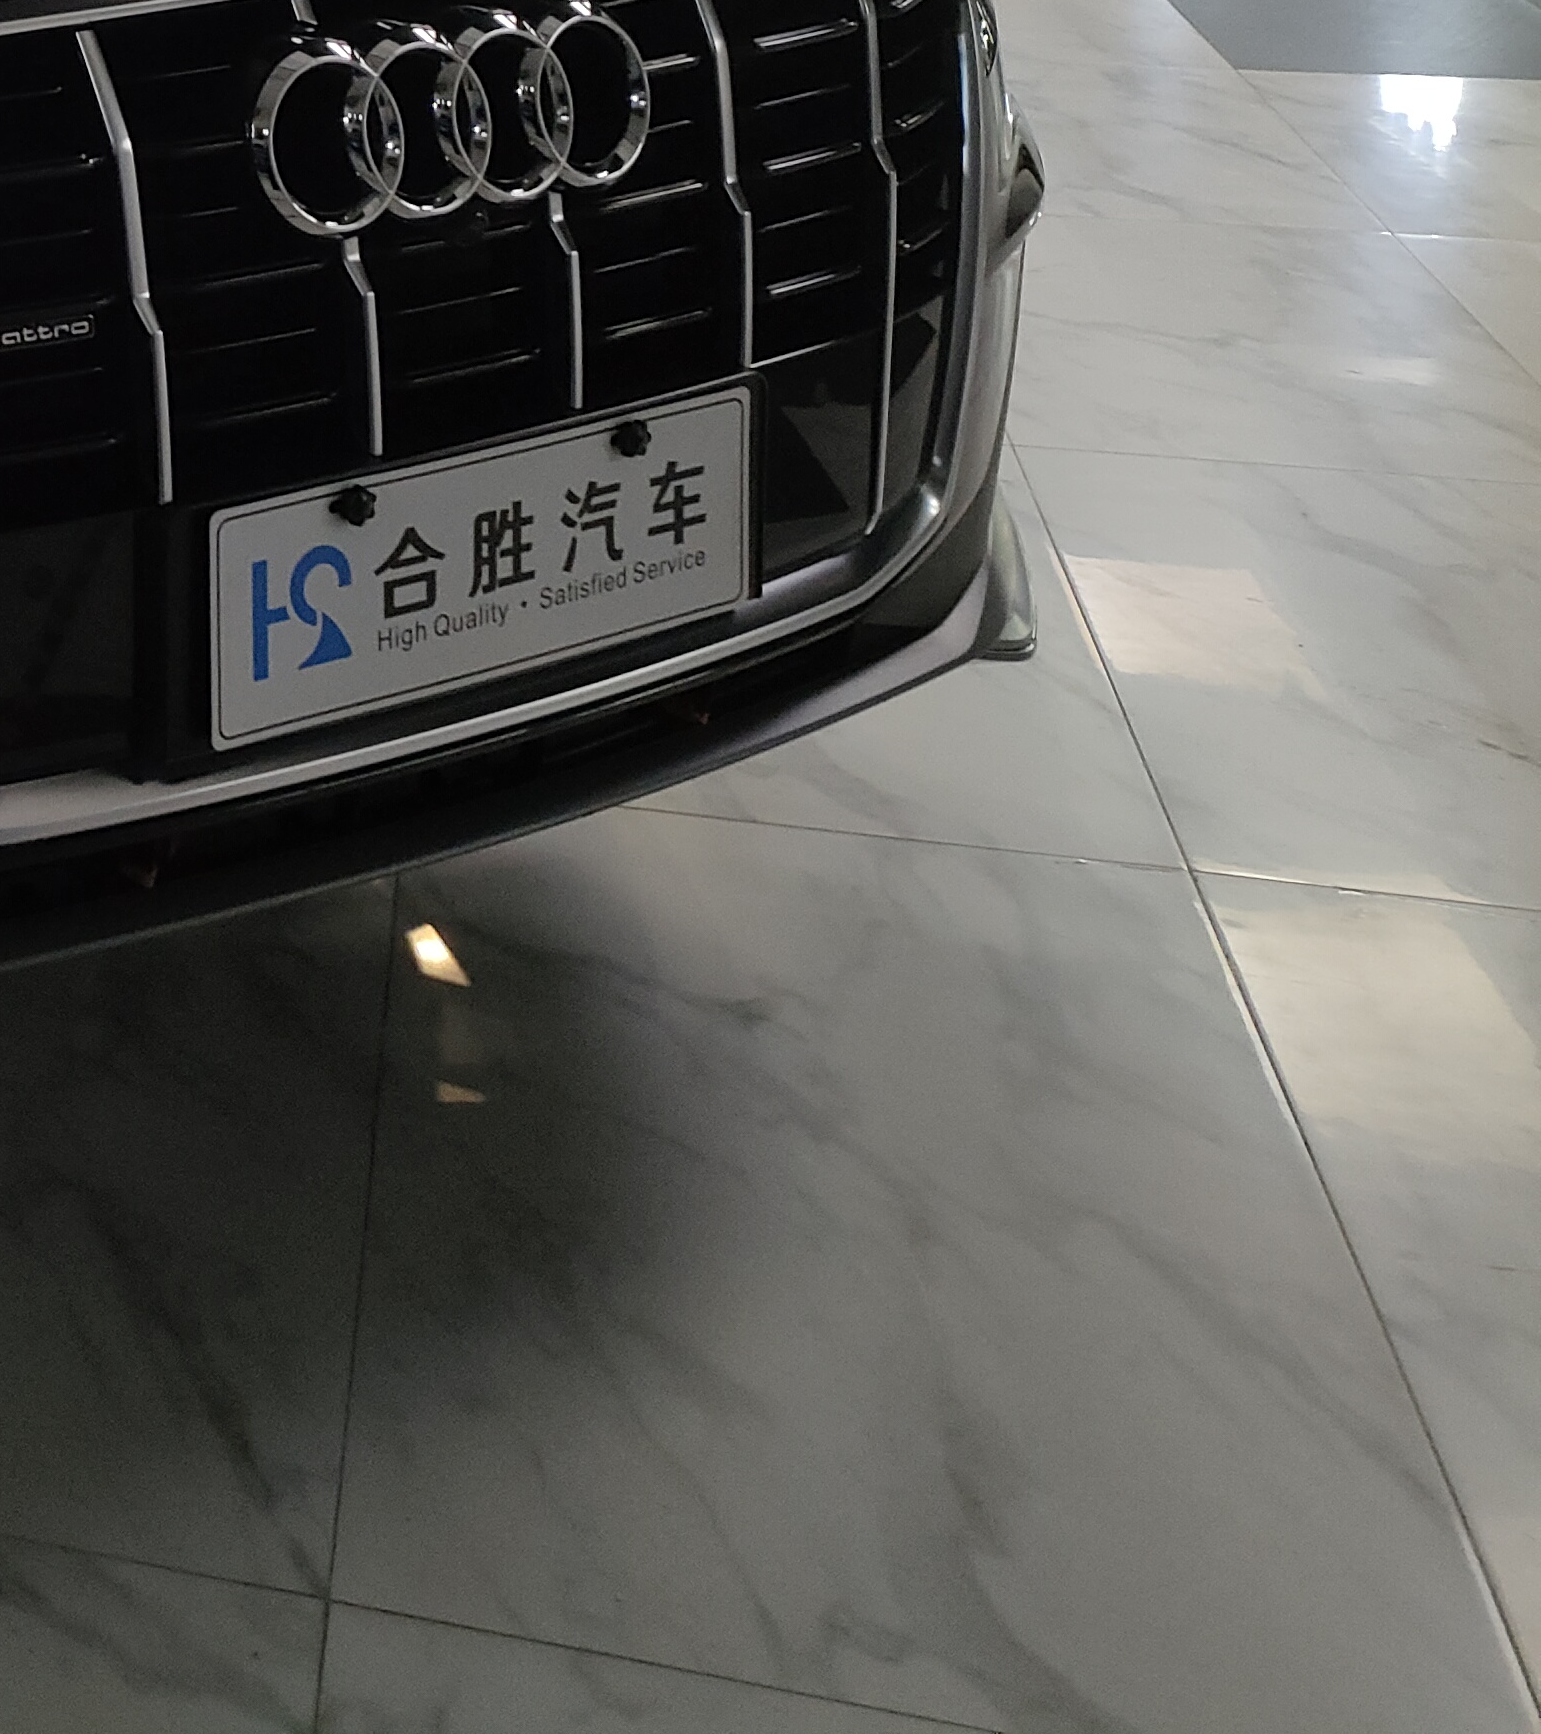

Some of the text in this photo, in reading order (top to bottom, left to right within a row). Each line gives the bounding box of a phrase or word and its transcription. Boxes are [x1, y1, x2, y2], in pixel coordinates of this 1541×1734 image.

[374, 460, 707, 619] 合胜汽车
[376, 547, 706, 653] High Quality Satisfied Service
